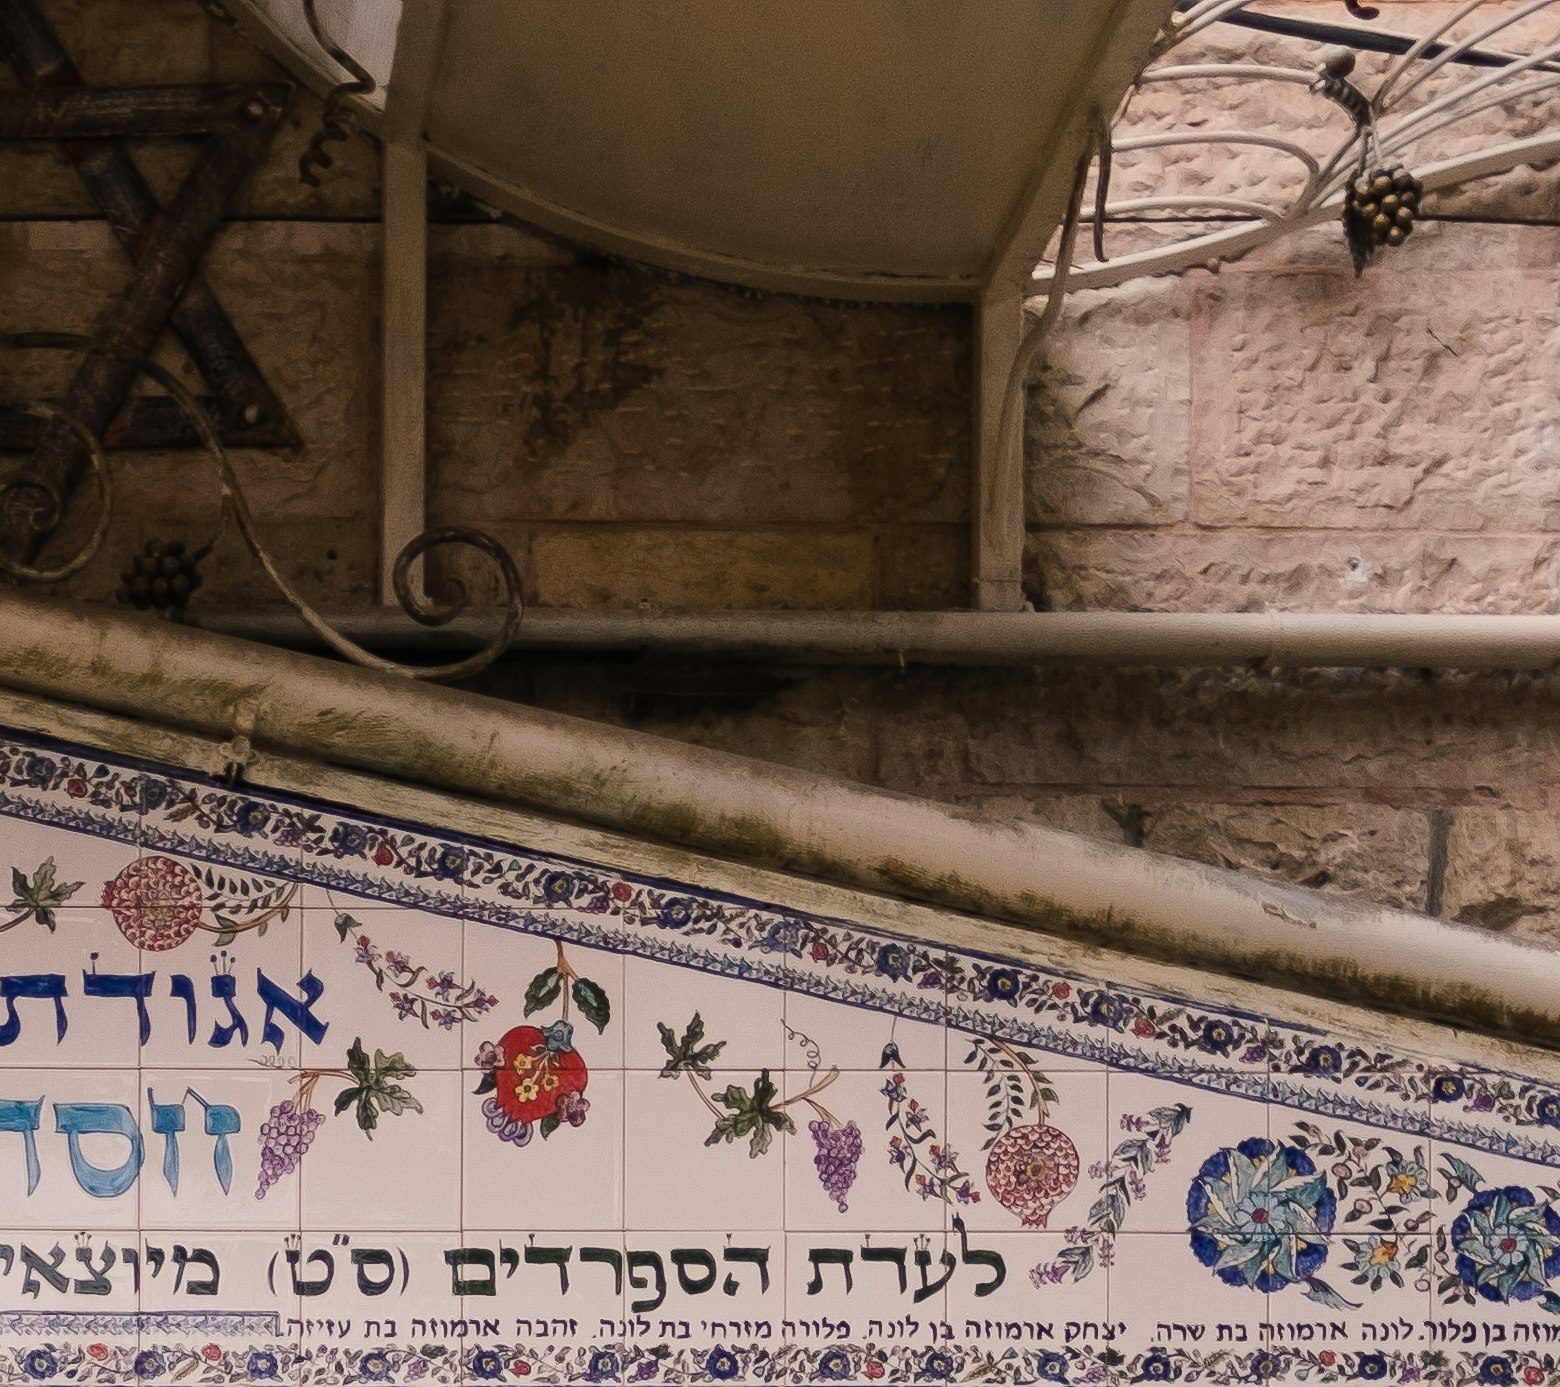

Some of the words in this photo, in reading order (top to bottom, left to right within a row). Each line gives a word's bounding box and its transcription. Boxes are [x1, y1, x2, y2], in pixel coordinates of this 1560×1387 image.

[807, 1213, 1006, 1304] לעדת
[444, 1234, 771, 1313] הספרדים
[365, 1318, 397, 1337] בת
[411, 1318, 500, 1337] ארמוזה
[517, 1319, 578, 1338] זהבה
[659, 1320, 691, 1339] בת
[702, 1320, 772, 1339] מזרחי
[782, 1315, 850, 1339] פלורה
[929, 1322, 954, 1344] בן
[965, 1320, 1054, 1341] ארמוזה
[1064, 1322, 1126, 1343] יצחק
[1216, 1321, 1247, 1342] בת
[1259, 1321, 1347, 1341] ארמוזה
[1362, 1317, 1413, 1341] לונה
[1482, 1322, 1506, 1347] בן
